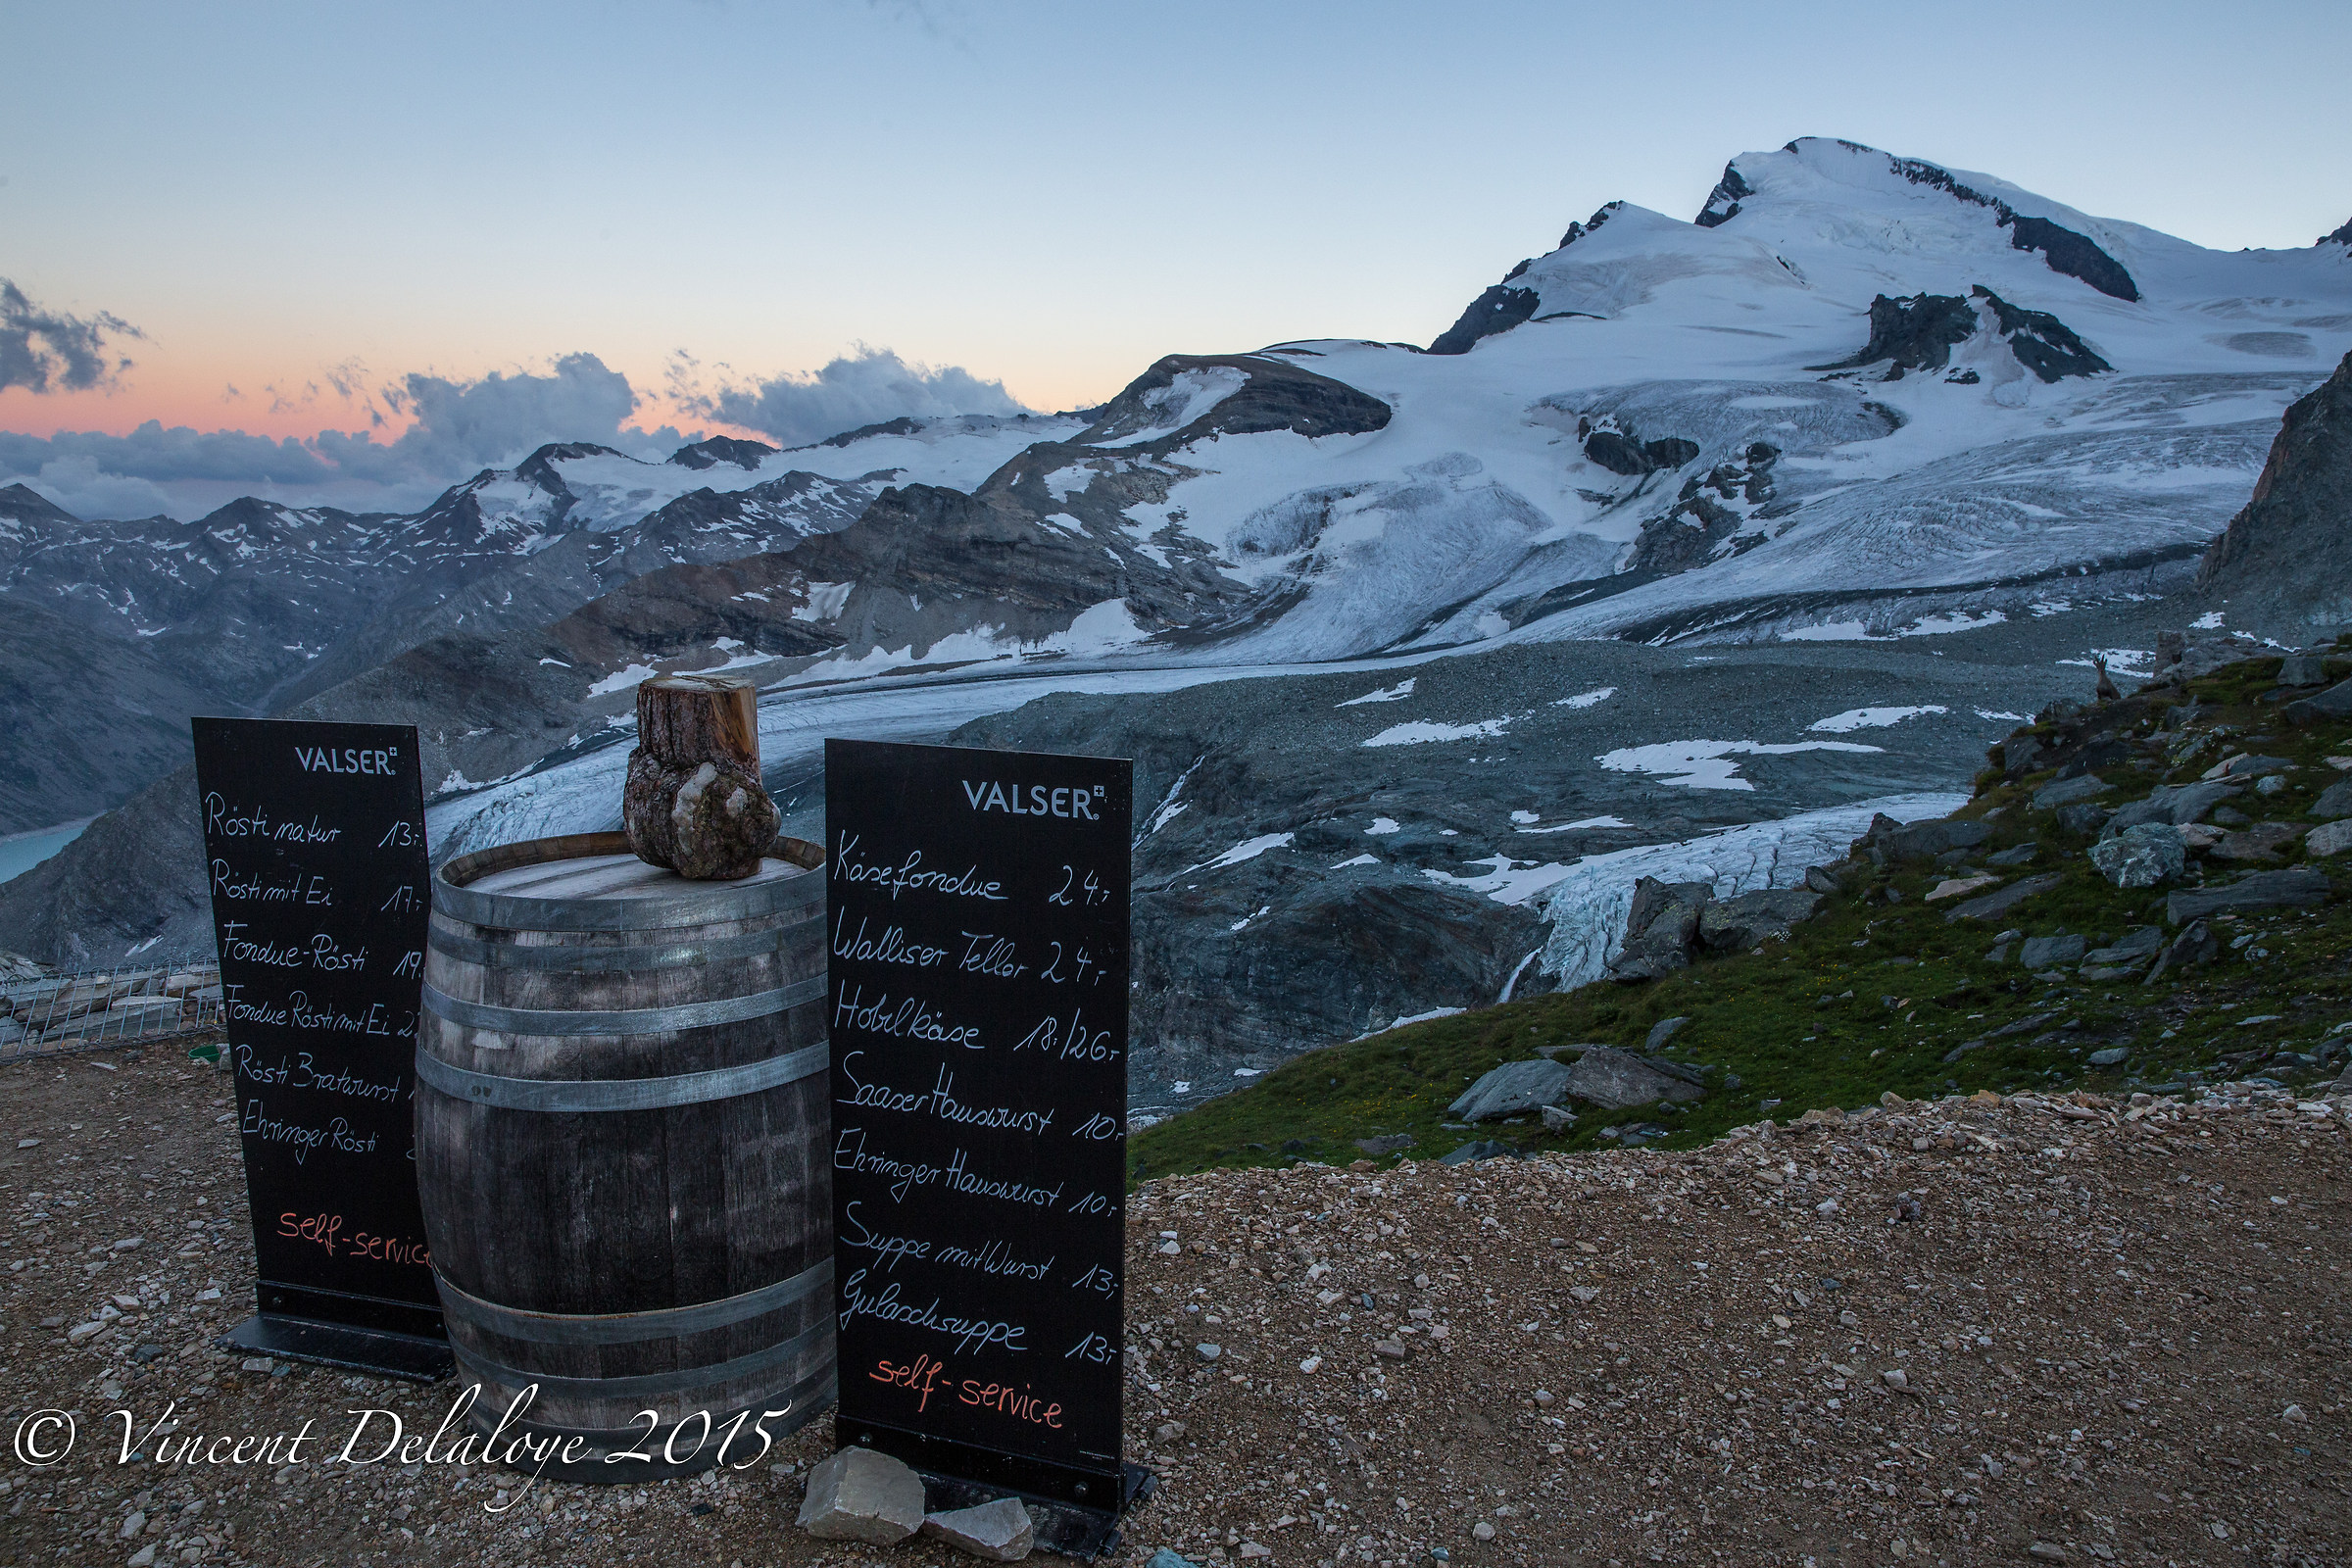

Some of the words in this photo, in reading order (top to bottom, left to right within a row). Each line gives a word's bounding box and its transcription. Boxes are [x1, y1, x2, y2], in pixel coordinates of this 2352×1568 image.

[294, 747, 392, 775] VALSER
[205, 791, 270, 836] Rösti
[273, 814, 341, 843] natur
[961, 780, 1094, 820] VALSER
[262, 873, 301, 902] mit
[305, 876, 332, 906] Ei
[833, 829, 1009, 901] Käsefondue
[223, 919, 368, 971] Fondue-Rösti
[833, 906, 950, 966] Walliser
[958, 930, 1029, 978] Teller
[226, 984, 287, 1026] Fondue
[289, 990, 334, 1028] Rösti
[333, 1009, 366, 1033] mit
[367, 1004, 390, 1035] Ei
[834, 978, 985, 1050] Hobelkäse
[235, 1044, 291, 1084] Rösti
[293, 1052, 400, 1102] Bratwurst
[836, 1051, 929, 1112] Saaser
[930, 1061, 1054, 1136] Hauswurst
[242, 1099, 328, 1165] Ehringer
[329, 1117, 379, 1152] Rösti
[834, 1128, 941, 1203] Ehringer
[945, 1148, 1064, 1208] Hauswurst
[840, 1200, 930, 1273] Suppe
[934, 1240, 990, 1269] mit
[985, 1241, 1055, 1280] Wurst
[840, 1268, 1028, 1355] Gulaschsuppe
[869, 1354, 1062, 1429] self-service
